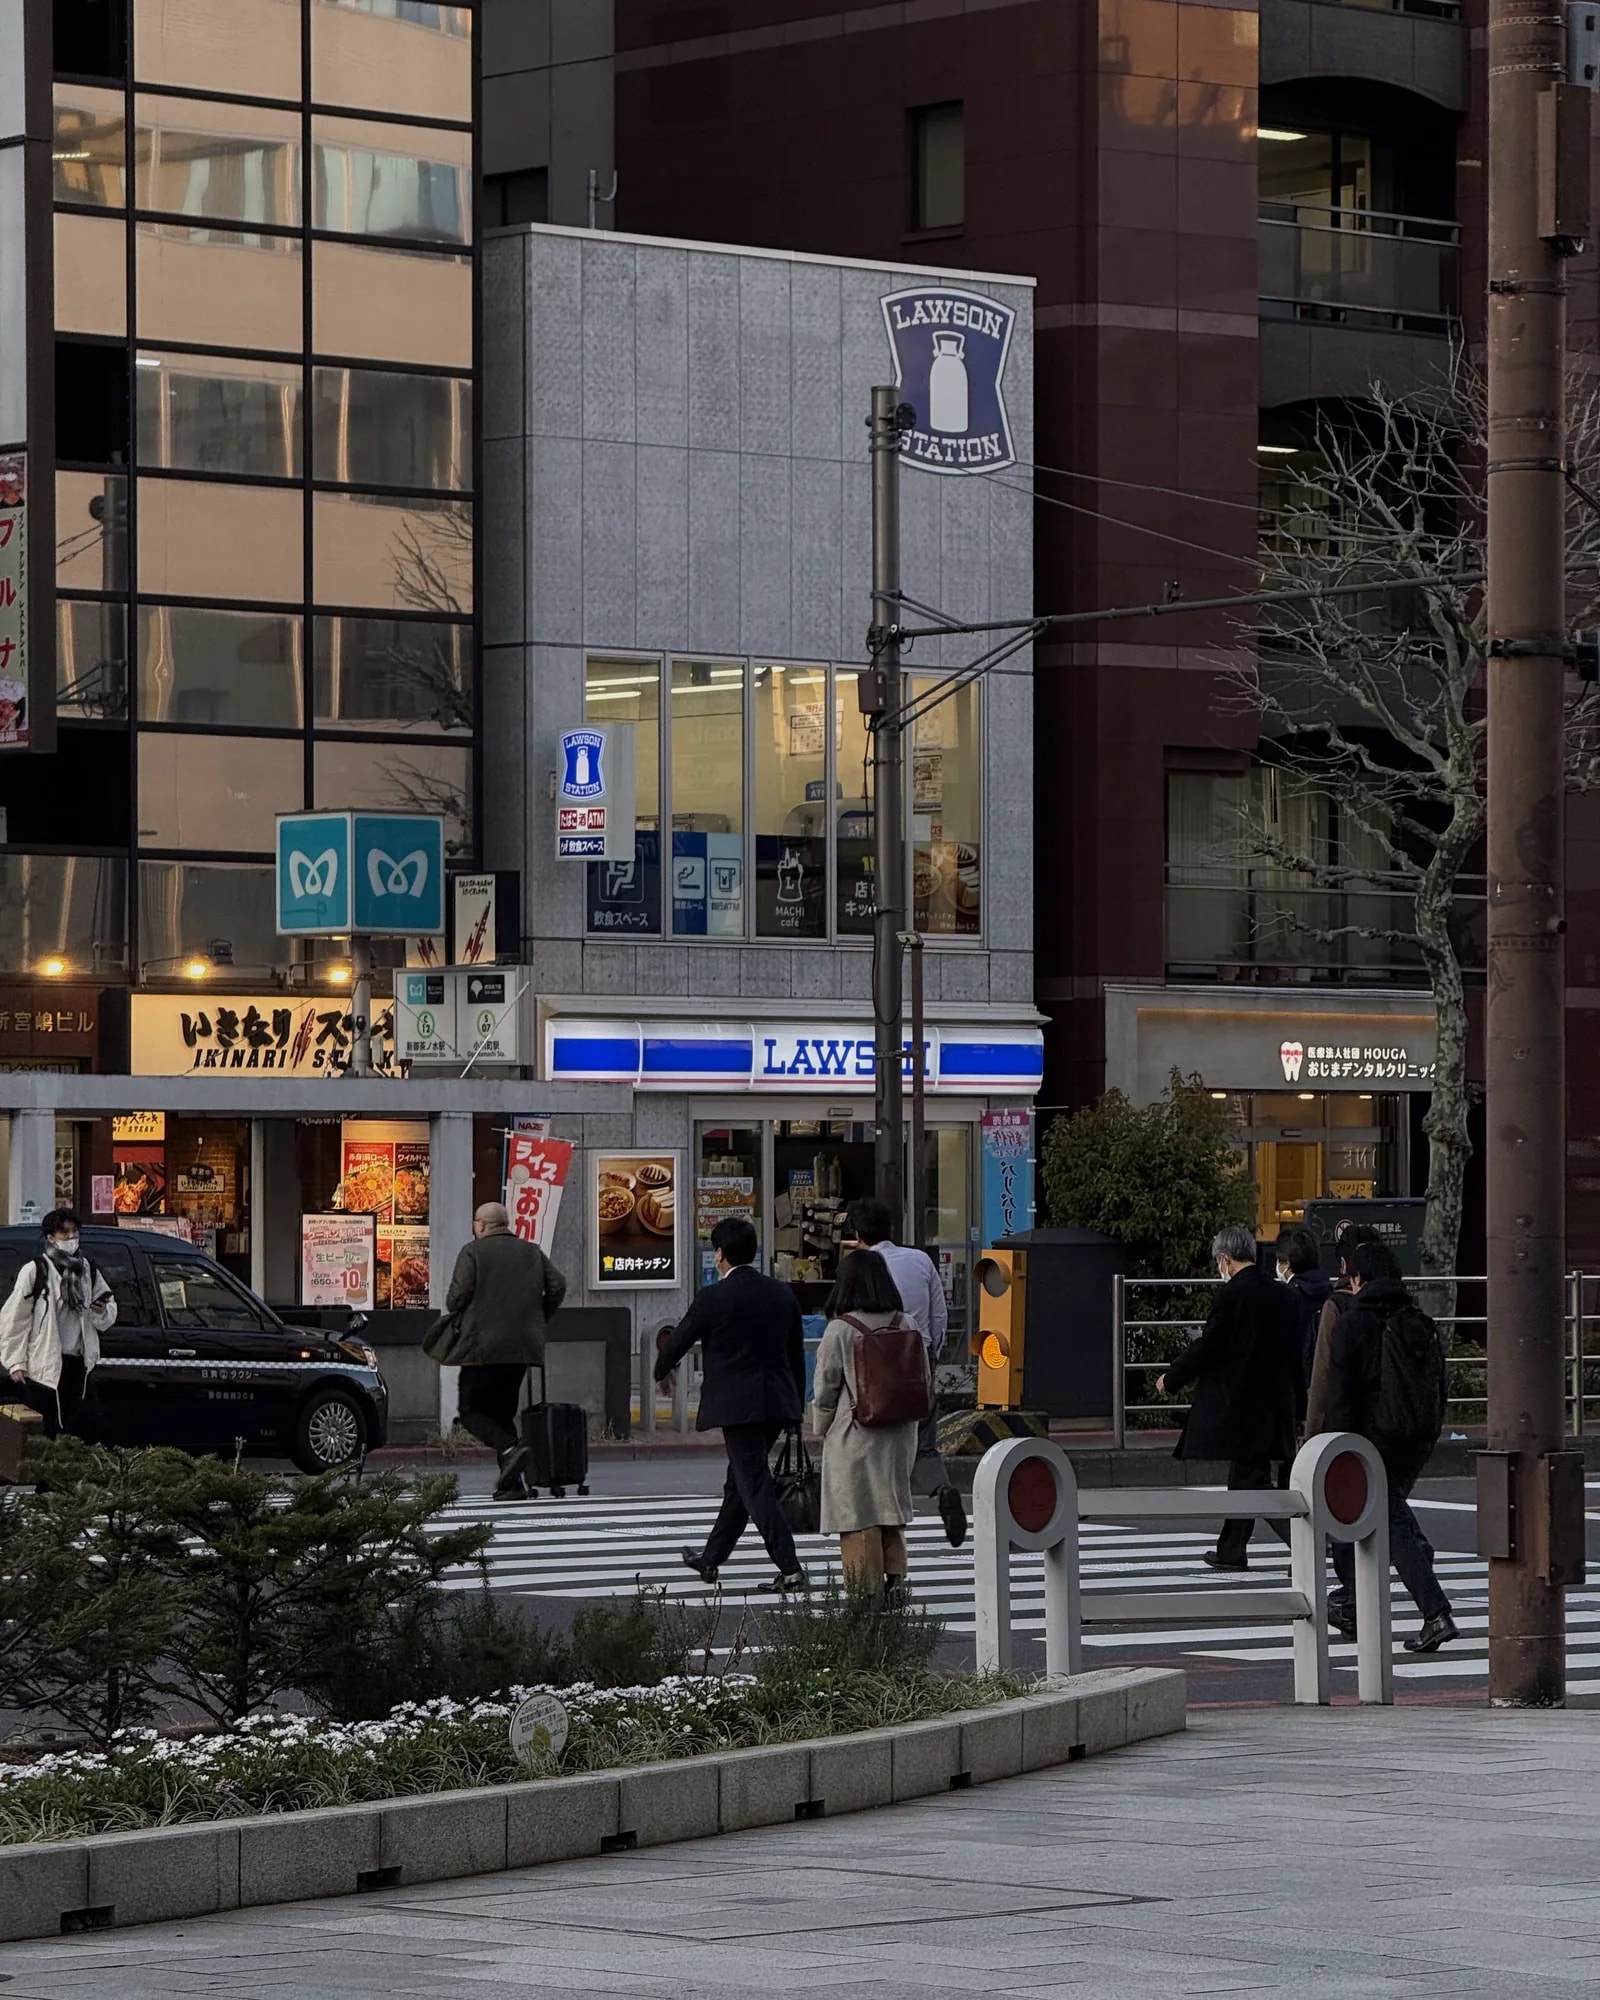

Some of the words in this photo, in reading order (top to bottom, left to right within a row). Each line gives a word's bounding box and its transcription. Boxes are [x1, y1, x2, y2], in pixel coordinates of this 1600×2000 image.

[893, 300, 1003, 340] LAWSON
[898, 429, 1002, 463] STATION
[565, 735, 601, 749] LAWSON
[565, 782, 601, 796] STATION
[561, 811, 577, 828] たばこ
[588, 810, 604, 827] ATM
[569, 839, 604, 853] 飲食スペース
[593, 910, 649, 927] 飲食スペース
[775, 905, 805, 918] MACHI
[780, 917, 800, 928] café
[422, 1015, 428, 1024] C
[483, 1014, 489, 1023] S
[180, 1005, 293, 1048] いきなり
[421, 1024, 430, 1033] 12
[481, 1023, 491, 1033] 07
[193, 1049, 288, 1068] IKINARI
[763, 1038, 930, 1077] LAWSN
[1307, 1046, 1360, 1060] 医療法人社団
[1363, 1047, 1407, 1060] HOUGA
[128, 1125, 154, 1133] STEAK
[516, 1141, 558, 1182] ライス
[614, 1256, 672, 1271] 店内キッチン
[230, 1370, 260, 1380] タクシー
